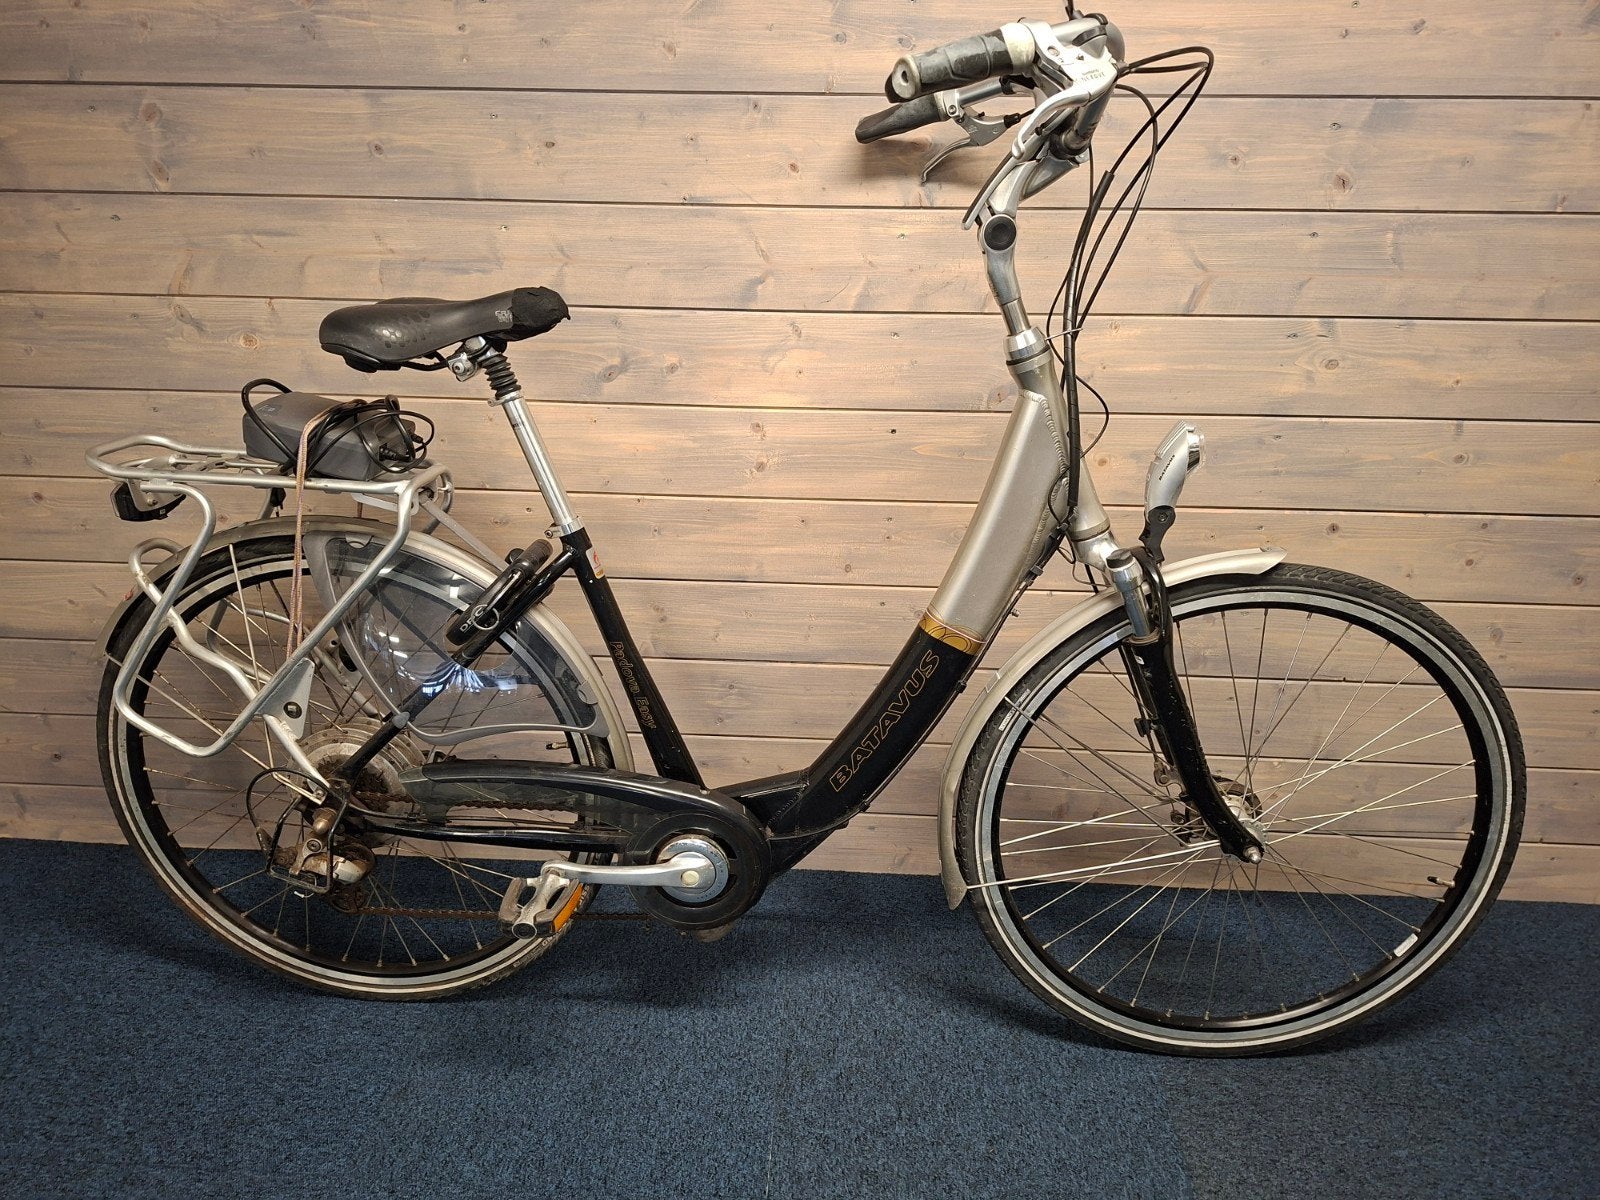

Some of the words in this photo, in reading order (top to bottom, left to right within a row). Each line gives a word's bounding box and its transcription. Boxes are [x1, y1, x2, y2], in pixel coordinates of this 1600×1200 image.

[610, 641, 640, 694] Padova
[634, 696, 657, 729] Easy
[829, 650, 940, 792] BATAVUS
